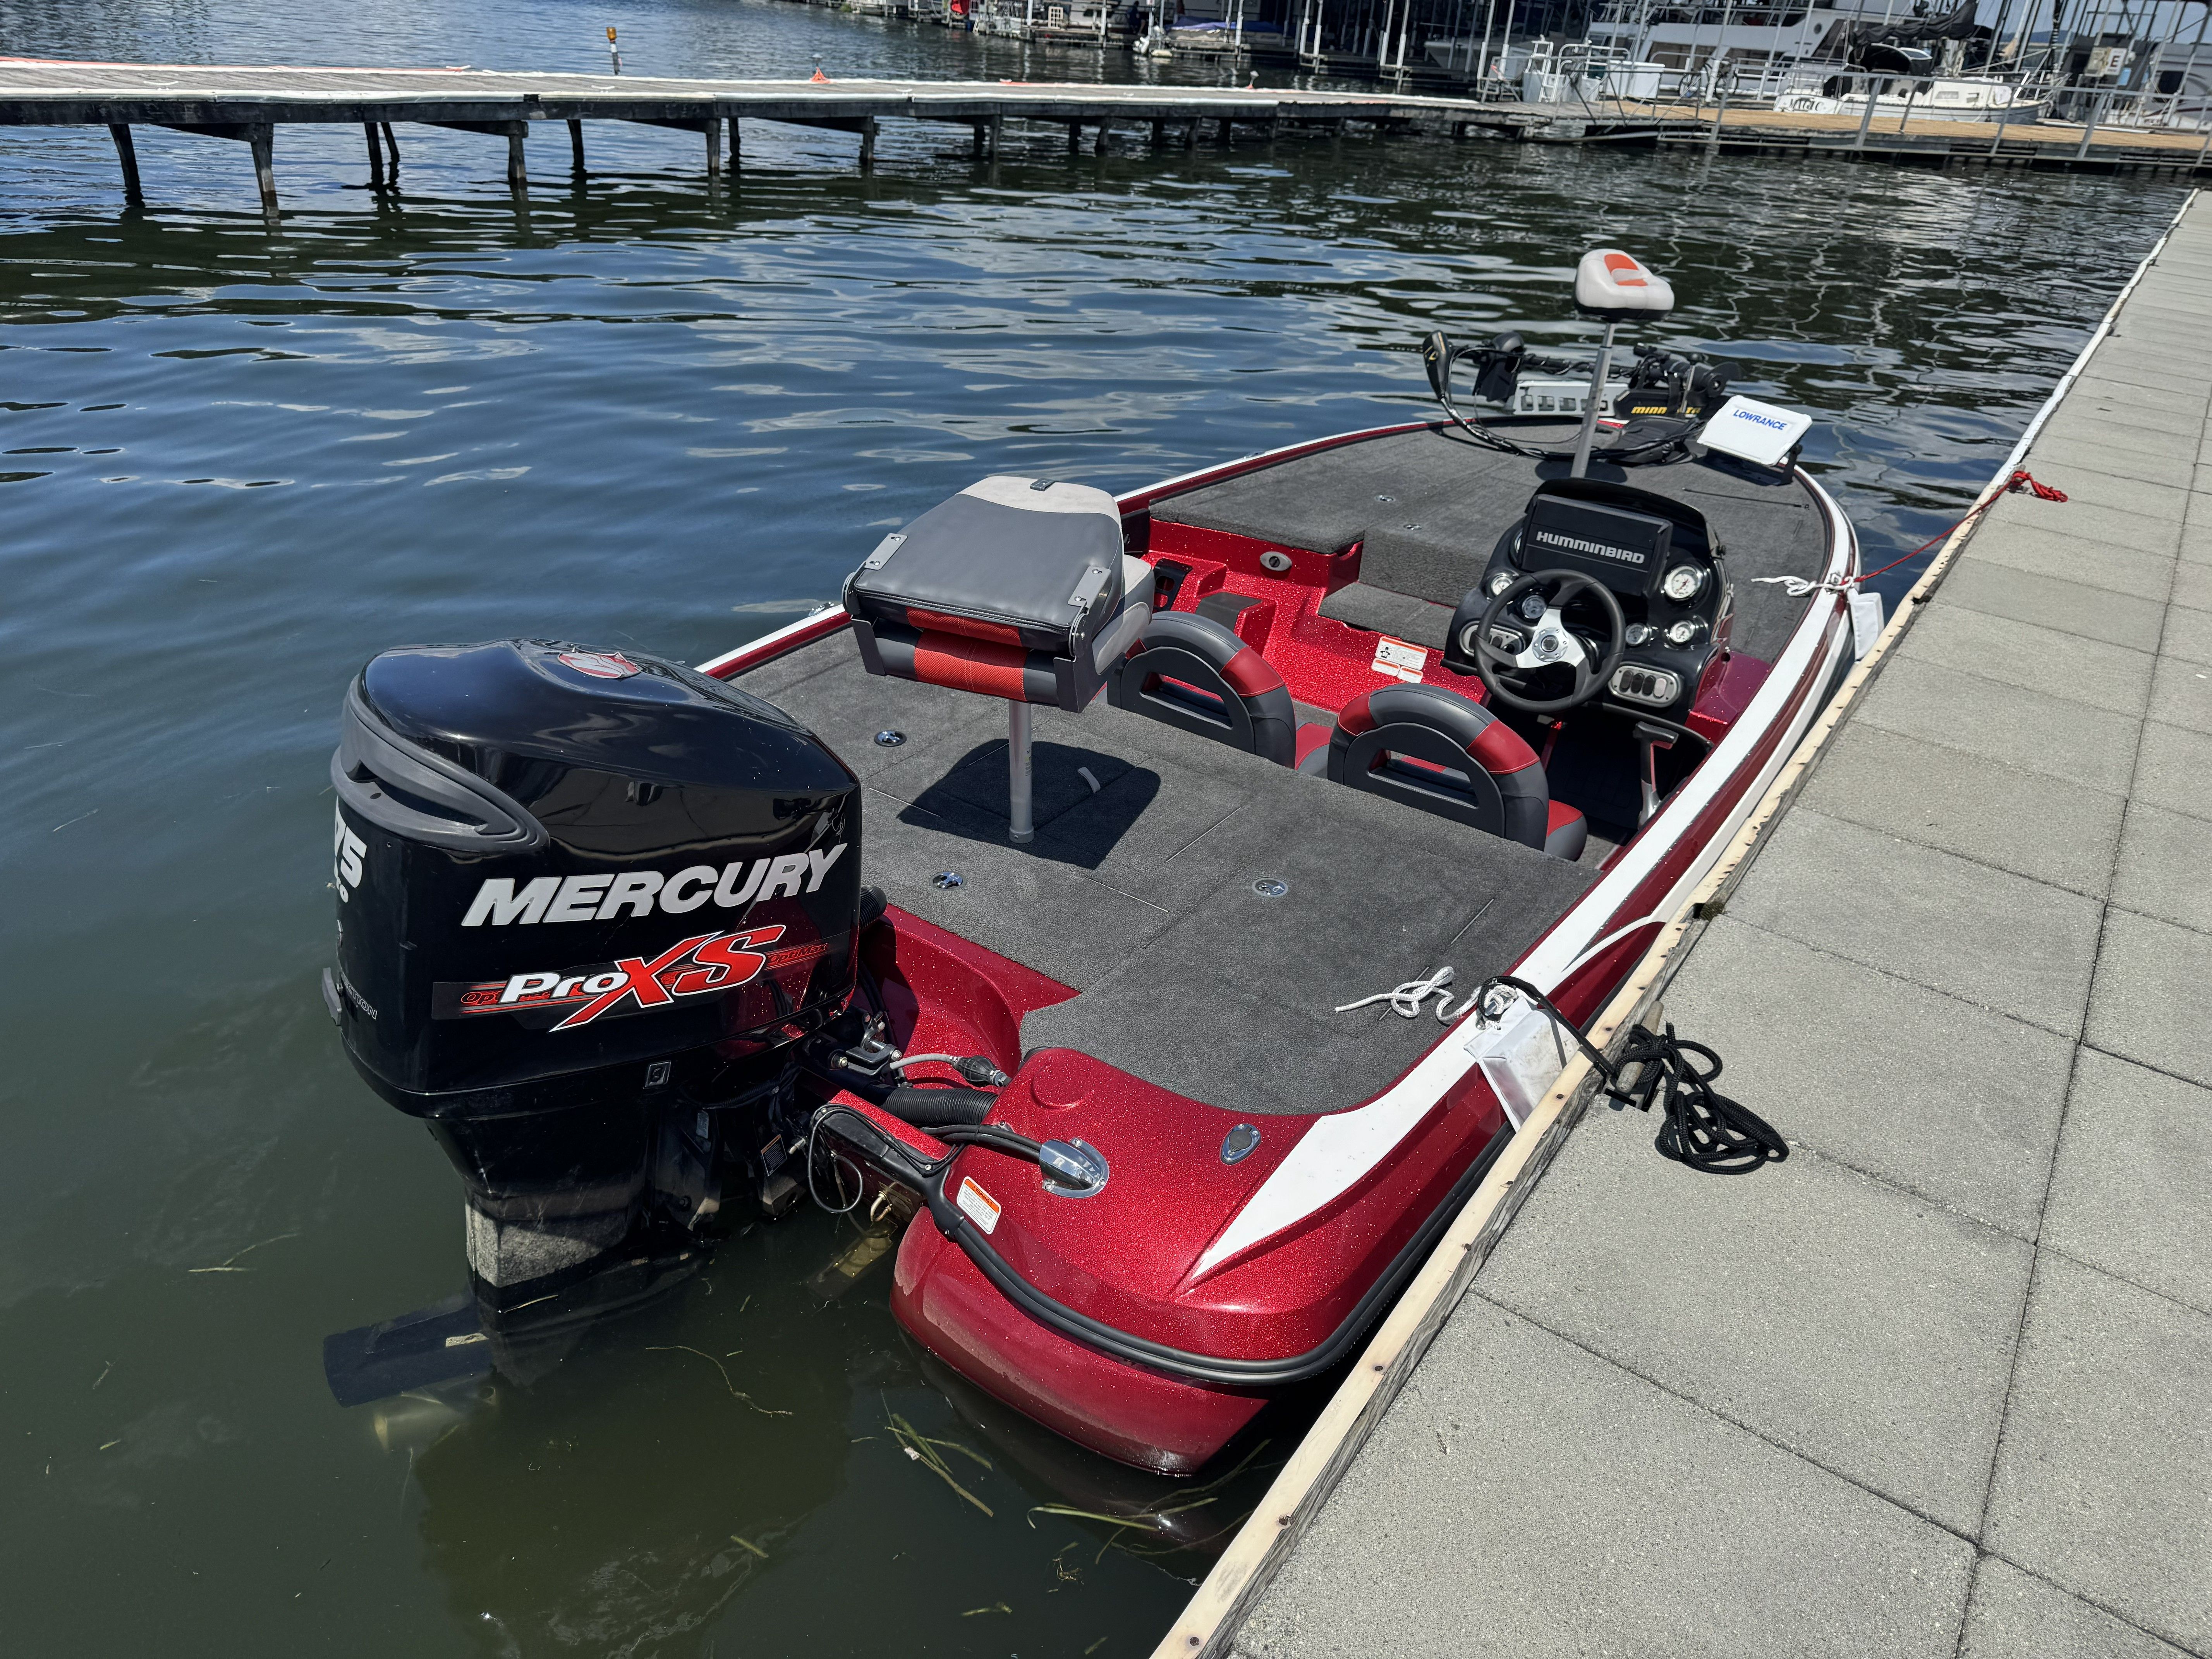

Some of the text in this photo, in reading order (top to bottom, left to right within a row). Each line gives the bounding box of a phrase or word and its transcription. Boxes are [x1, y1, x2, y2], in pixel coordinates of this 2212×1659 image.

[2110, 55, 2120, 67] E
[1733, 409, 1786, 431] LOWRANCE
[1537, 531, 1645, 564] HUMMINBIRD
[461, 843, 848, 927] MERCURY
[975, 1187, 990, 1204] WARNING
